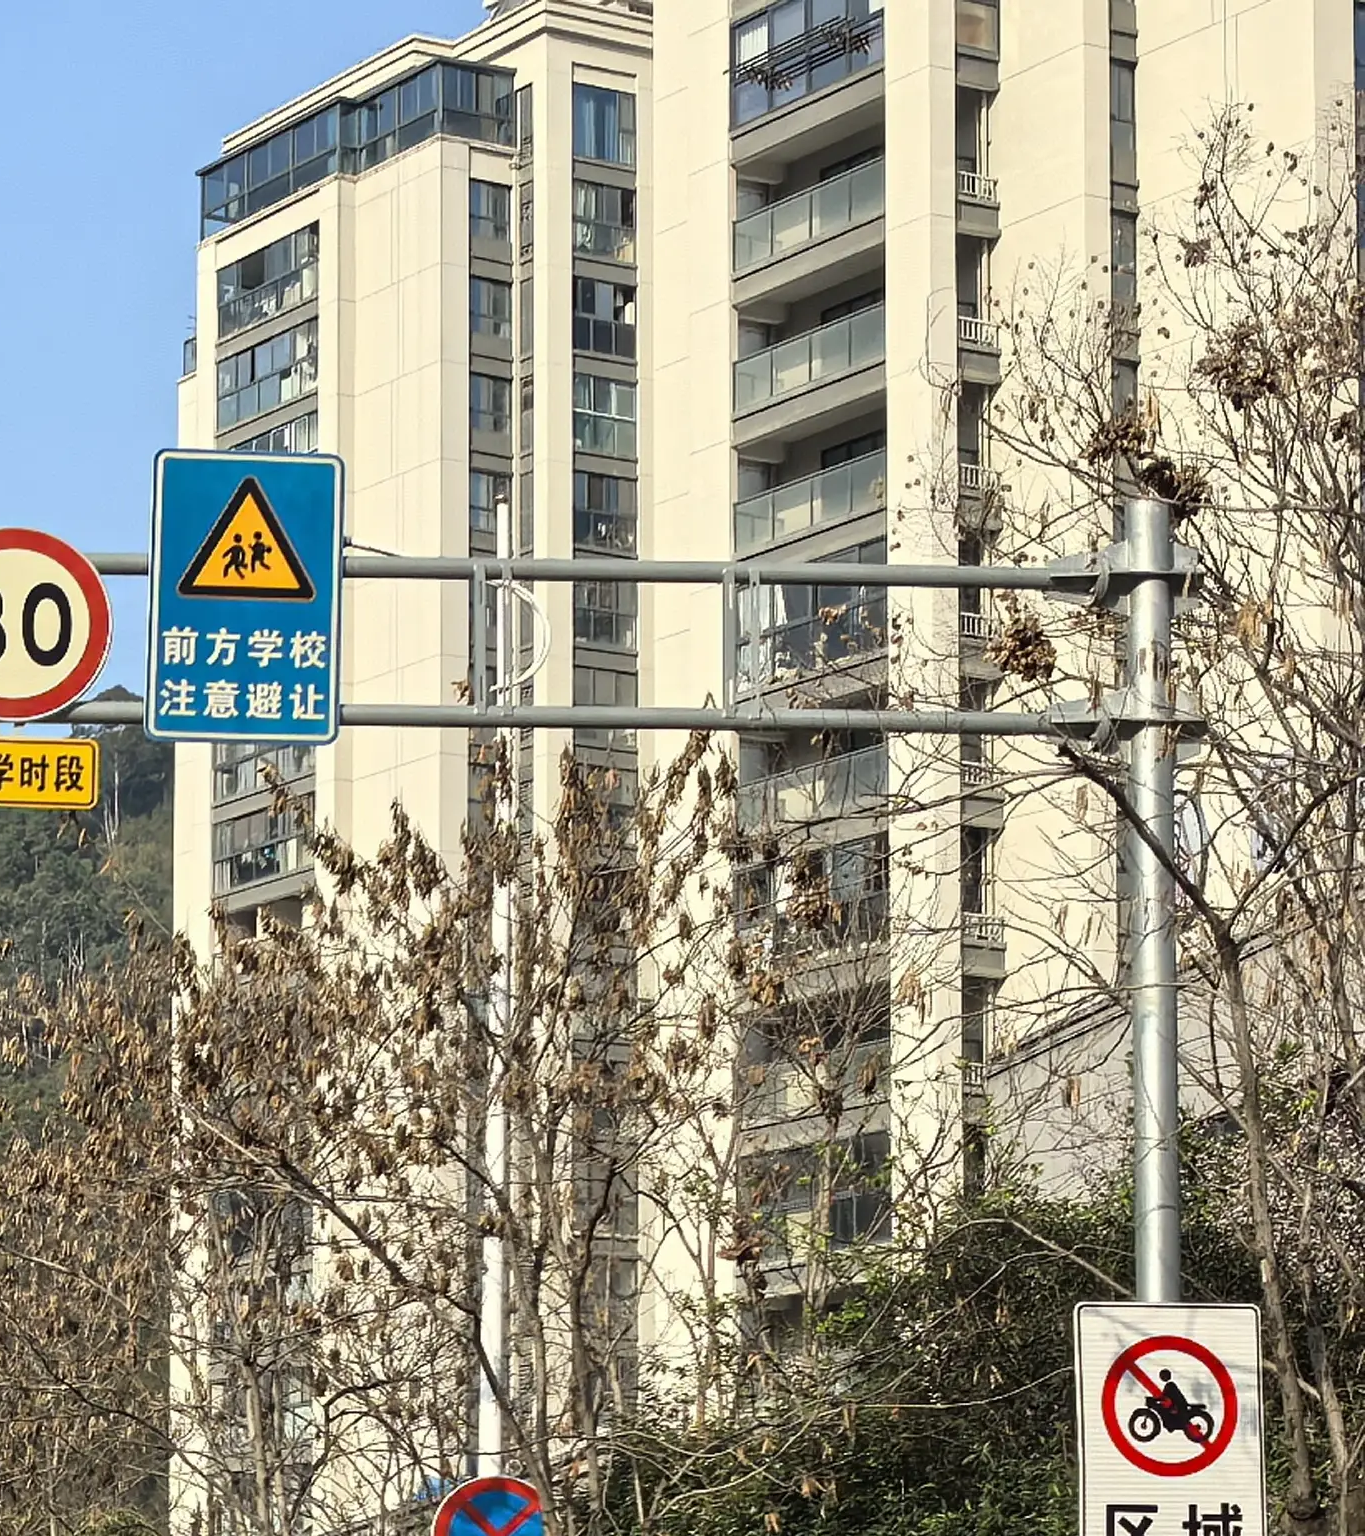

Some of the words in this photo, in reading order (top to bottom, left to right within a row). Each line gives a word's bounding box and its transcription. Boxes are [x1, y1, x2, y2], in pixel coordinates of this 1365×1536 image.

[161, 625, 327, 670] 前方学校
[159, 680, 326, 721] 注意避让
